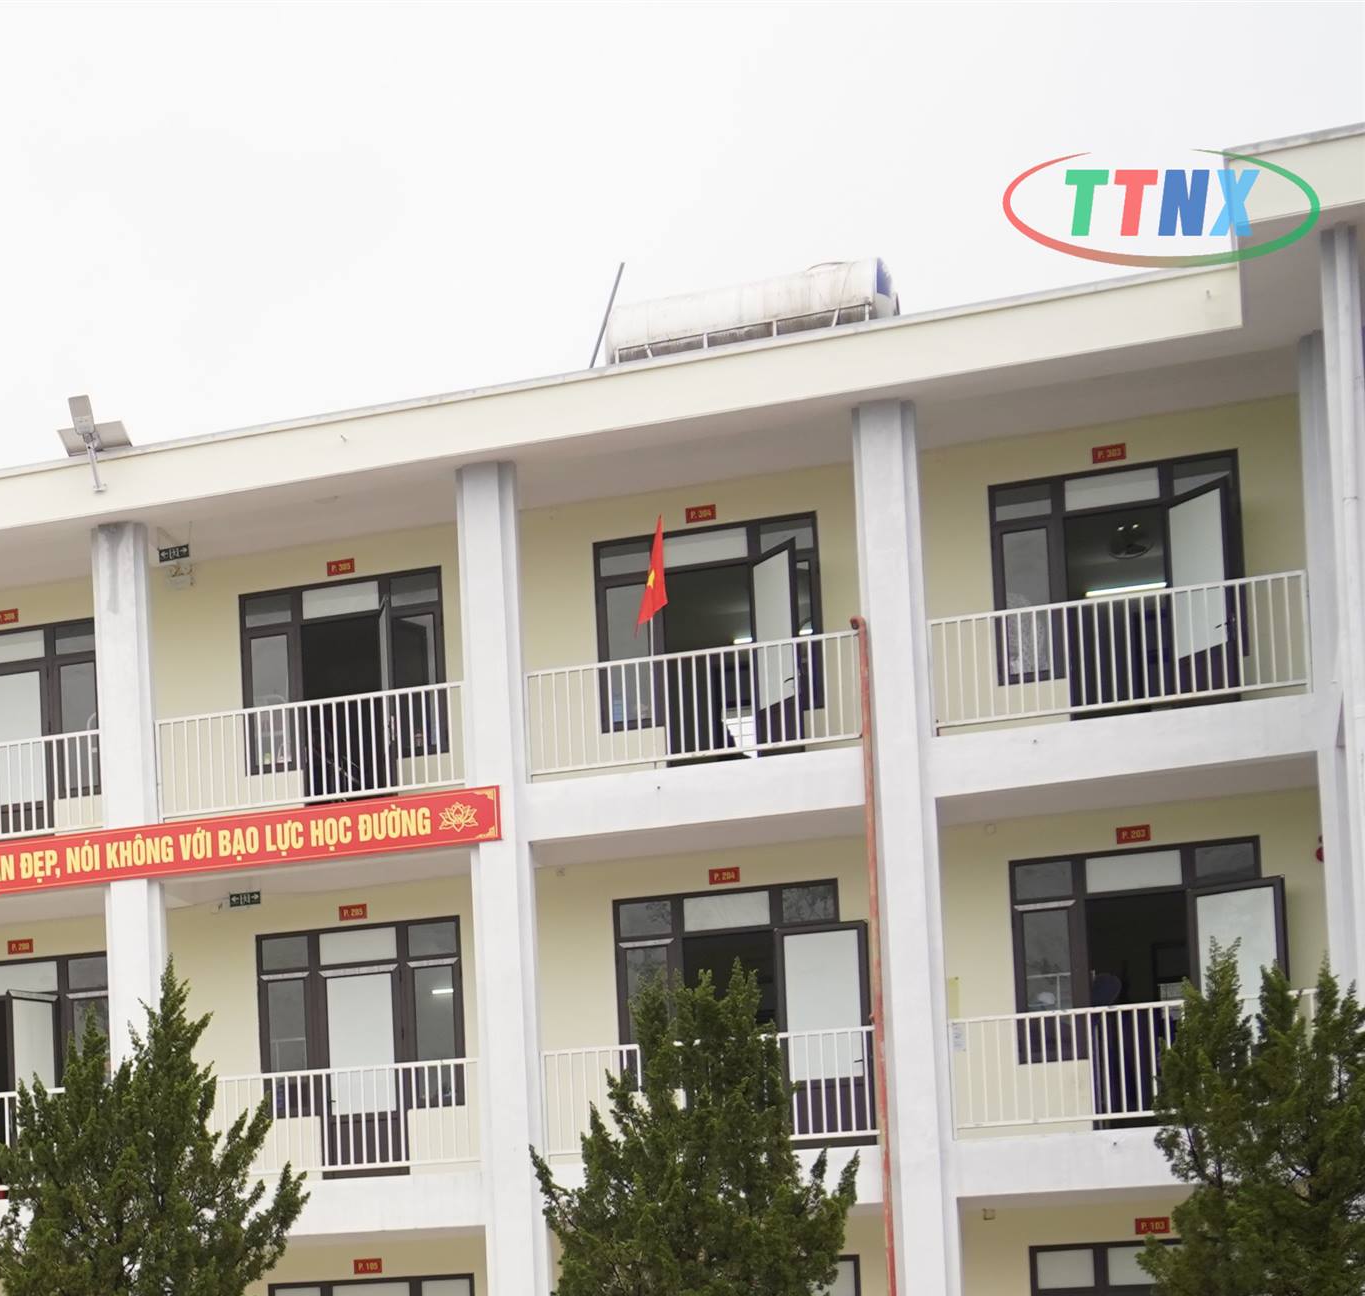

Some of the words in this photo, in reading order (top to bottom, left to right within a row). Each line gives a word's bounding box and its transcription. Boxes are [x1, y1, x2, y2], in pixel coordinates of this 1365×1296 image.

[20, 850, 61, 883] ĐẸP,
[66, 840, 100, 874] NÓI
[106, 833, 174, 869] KHÔNG
[179, 826, 212, 860] VỚI
[219, 826, 259, 861] BẠO
[265, 820, 303, 856] LỰC
[310, 816, 352, 851] HỌC
[358, 804, 431, 842] ĐƯỜNG
